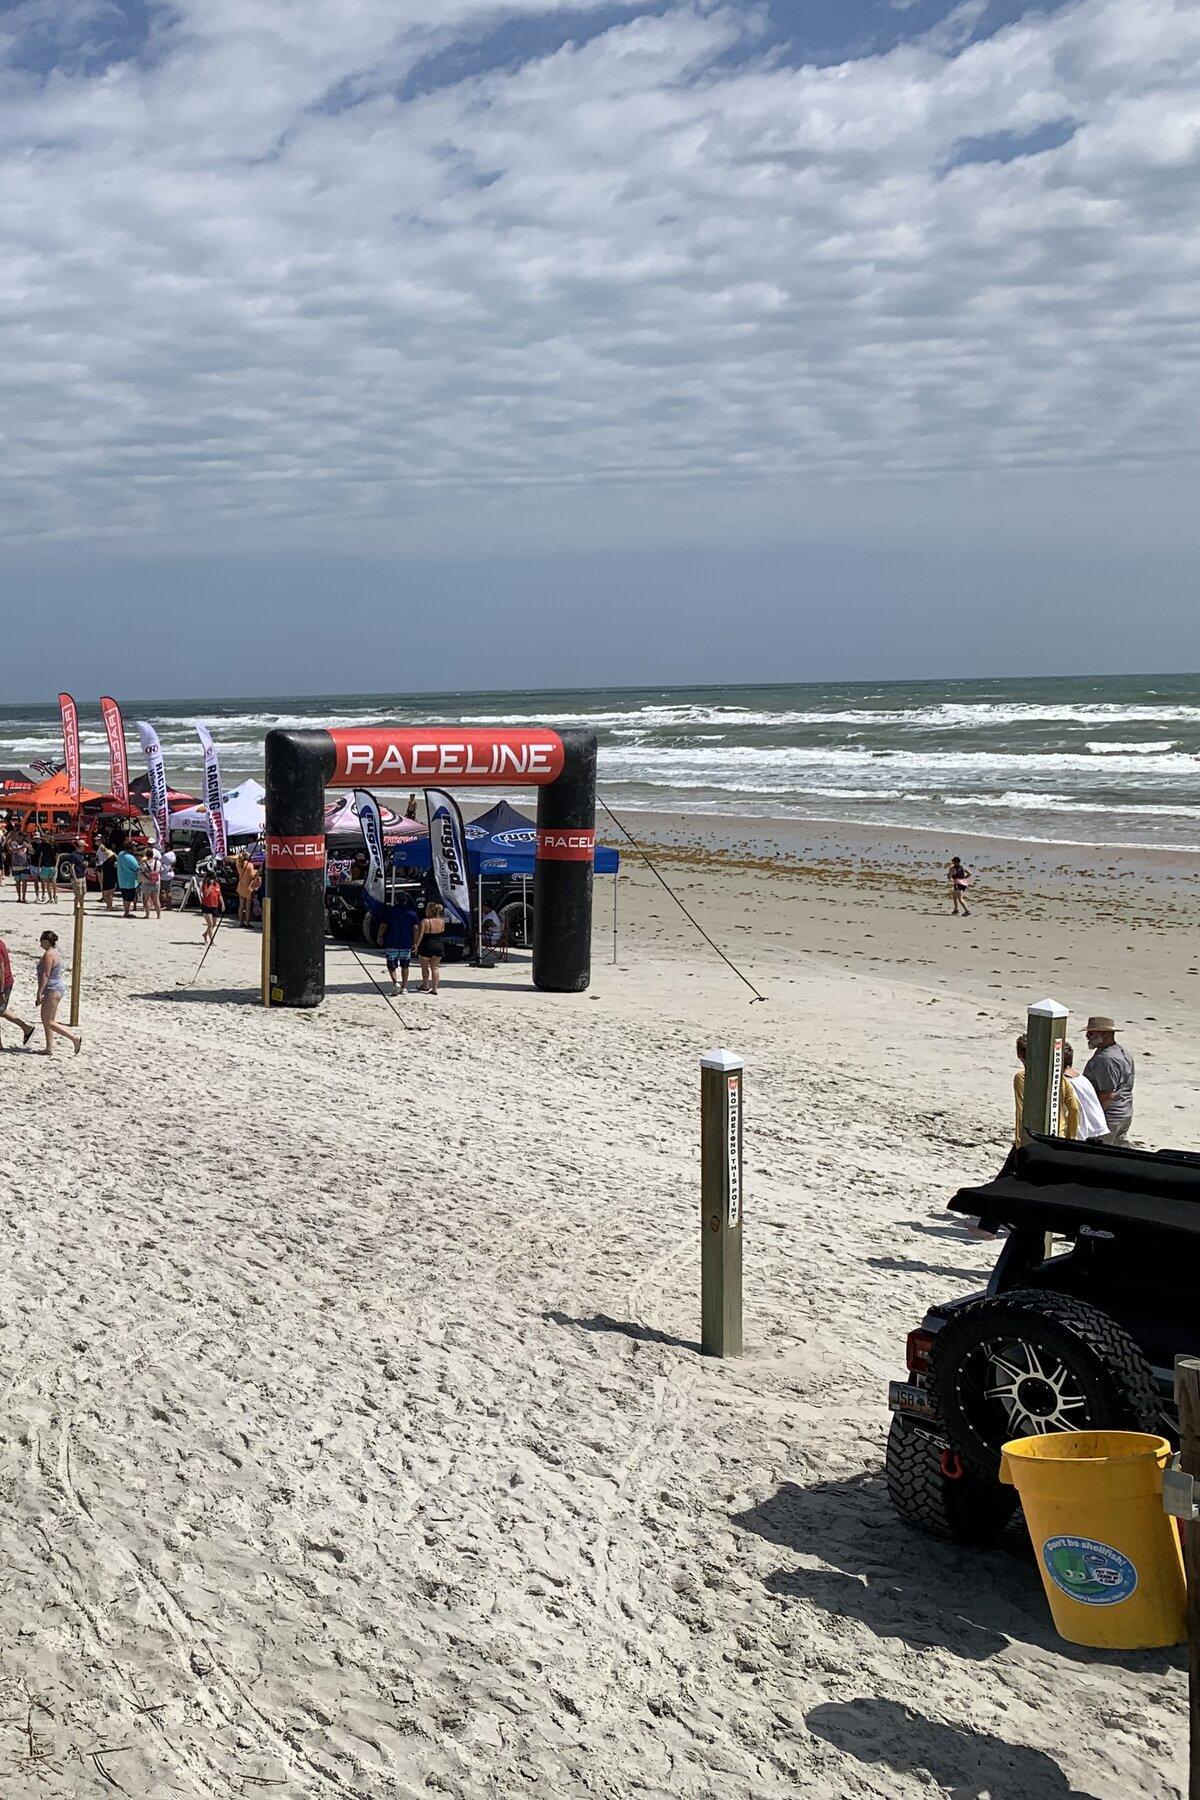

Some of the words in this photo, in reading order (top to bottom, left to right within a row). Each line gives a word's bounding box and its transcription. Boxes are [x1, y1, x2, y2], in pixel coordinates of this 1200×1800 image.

[345, 744, 554, 775] RACELINE
[155, 762, 167, 808] RACING
[207, 764, 220, 811] RACING
[498, 832, 537, 843] rug
[544, 836, 595, 848] RACELI
[271, 843, 325, 856] RACELI
[730, 1091, 737, 1104] NO
[1047, 1539, 1067, 1551] Don't
